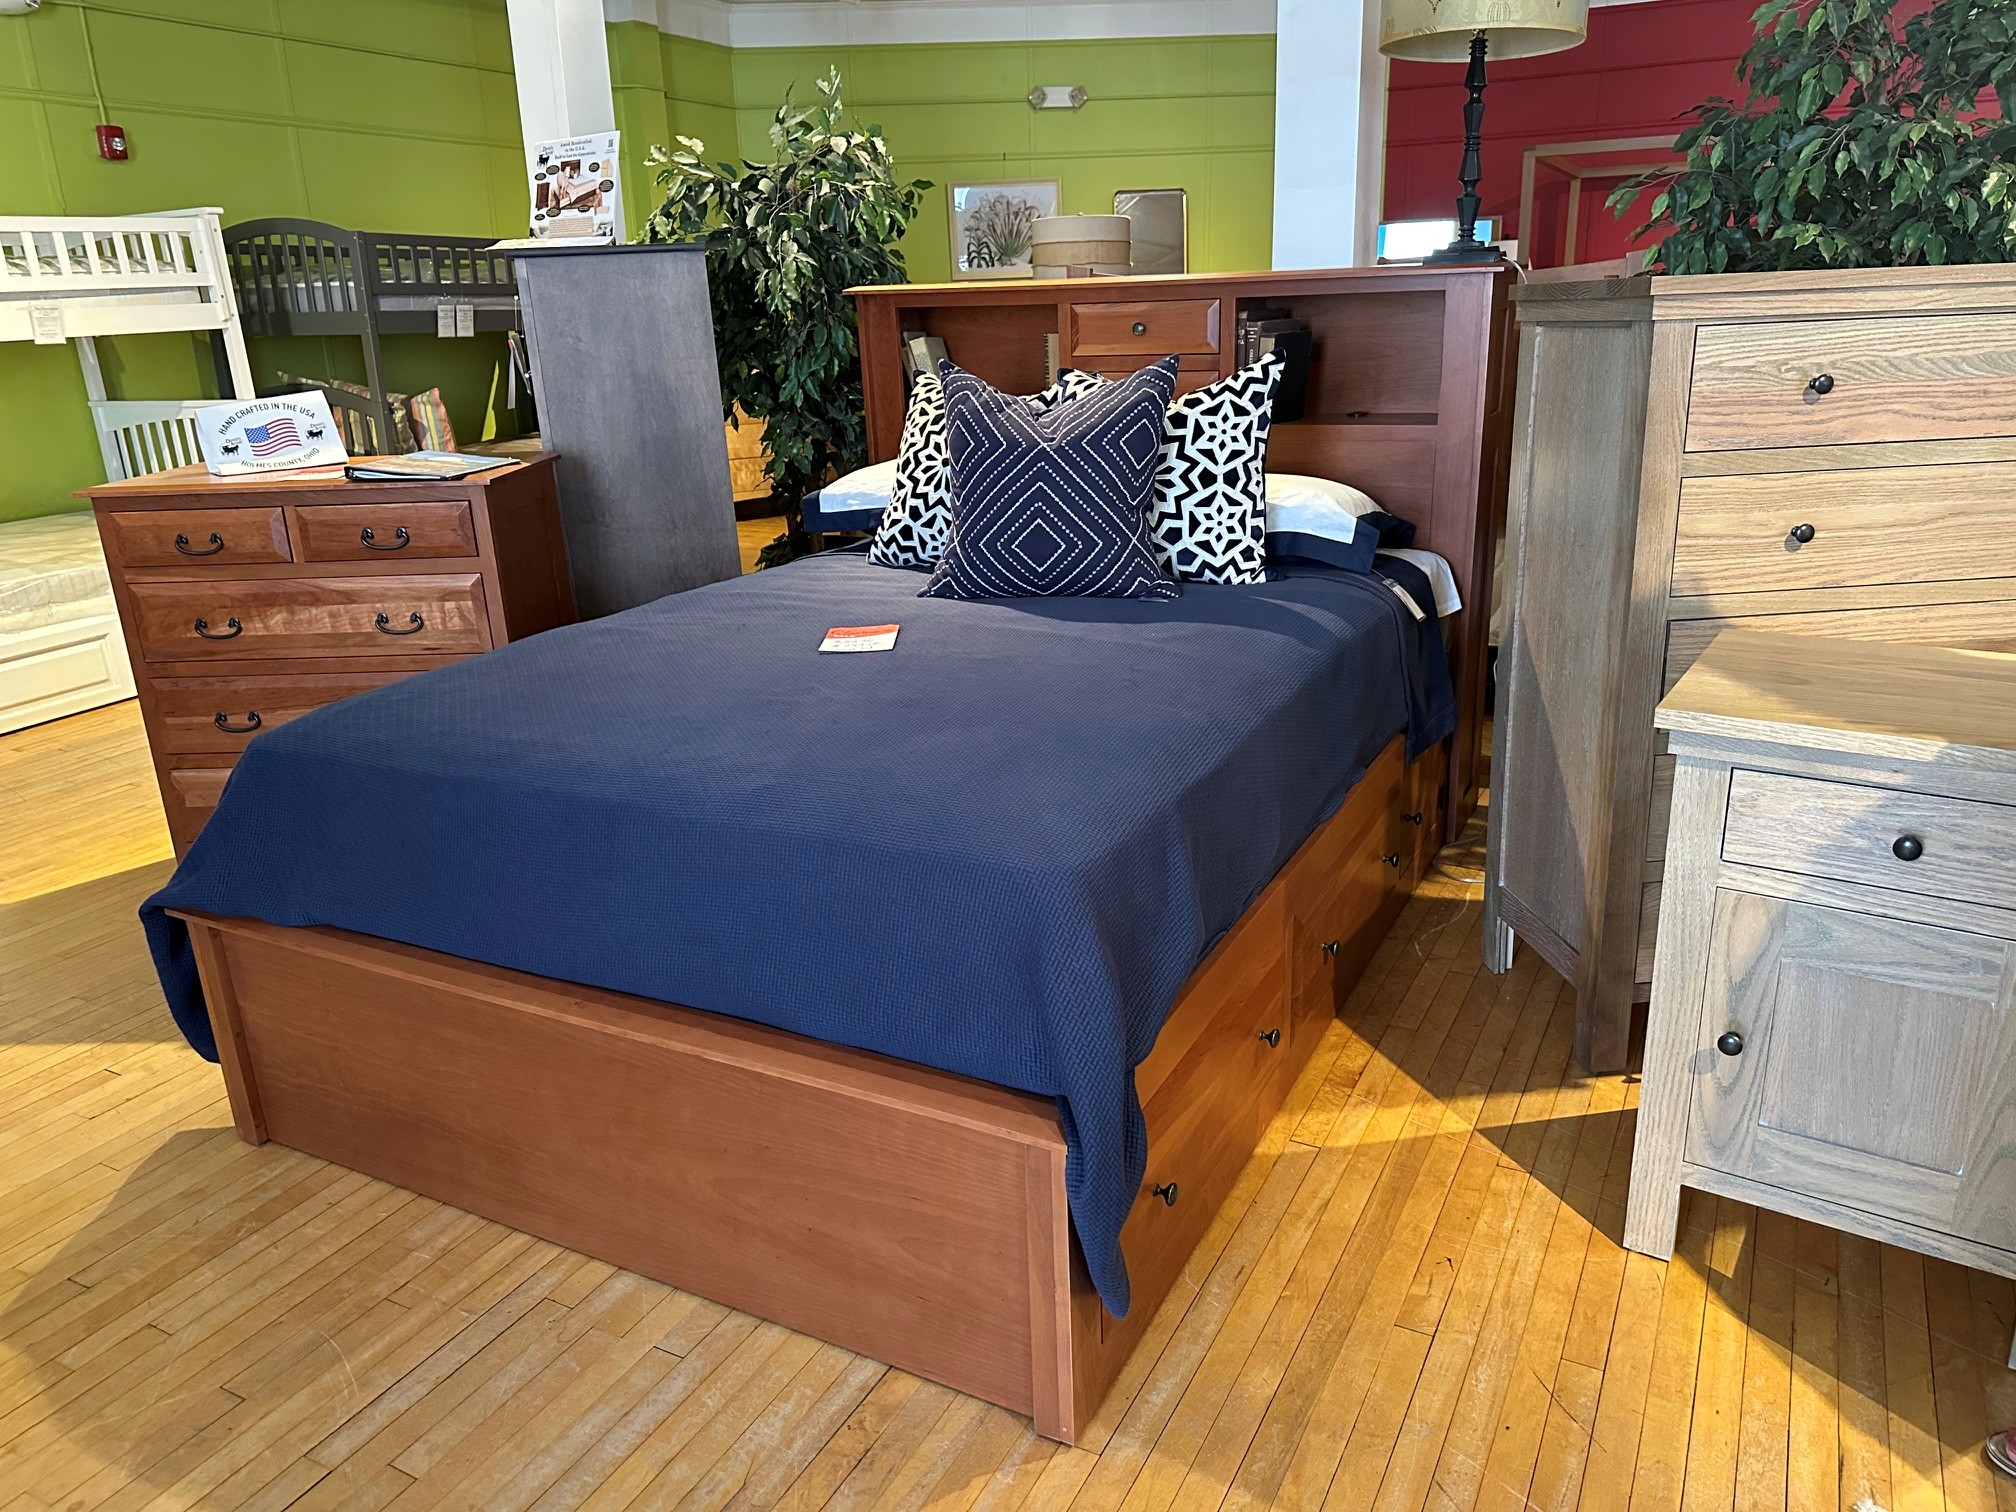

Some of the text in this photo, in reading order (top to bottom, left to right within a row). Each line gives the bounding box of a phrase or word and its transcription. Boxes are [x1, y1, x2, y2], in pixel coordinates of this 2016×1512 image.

[218, 415, 237, 435] HAND
[236, 403, 270, 419] CRAFTED
[282, 402, 297, 412] THE
[300, 406, 316, 419] USA
[241, 448, 320, 468] HOLMES COUNTY, OHIO
